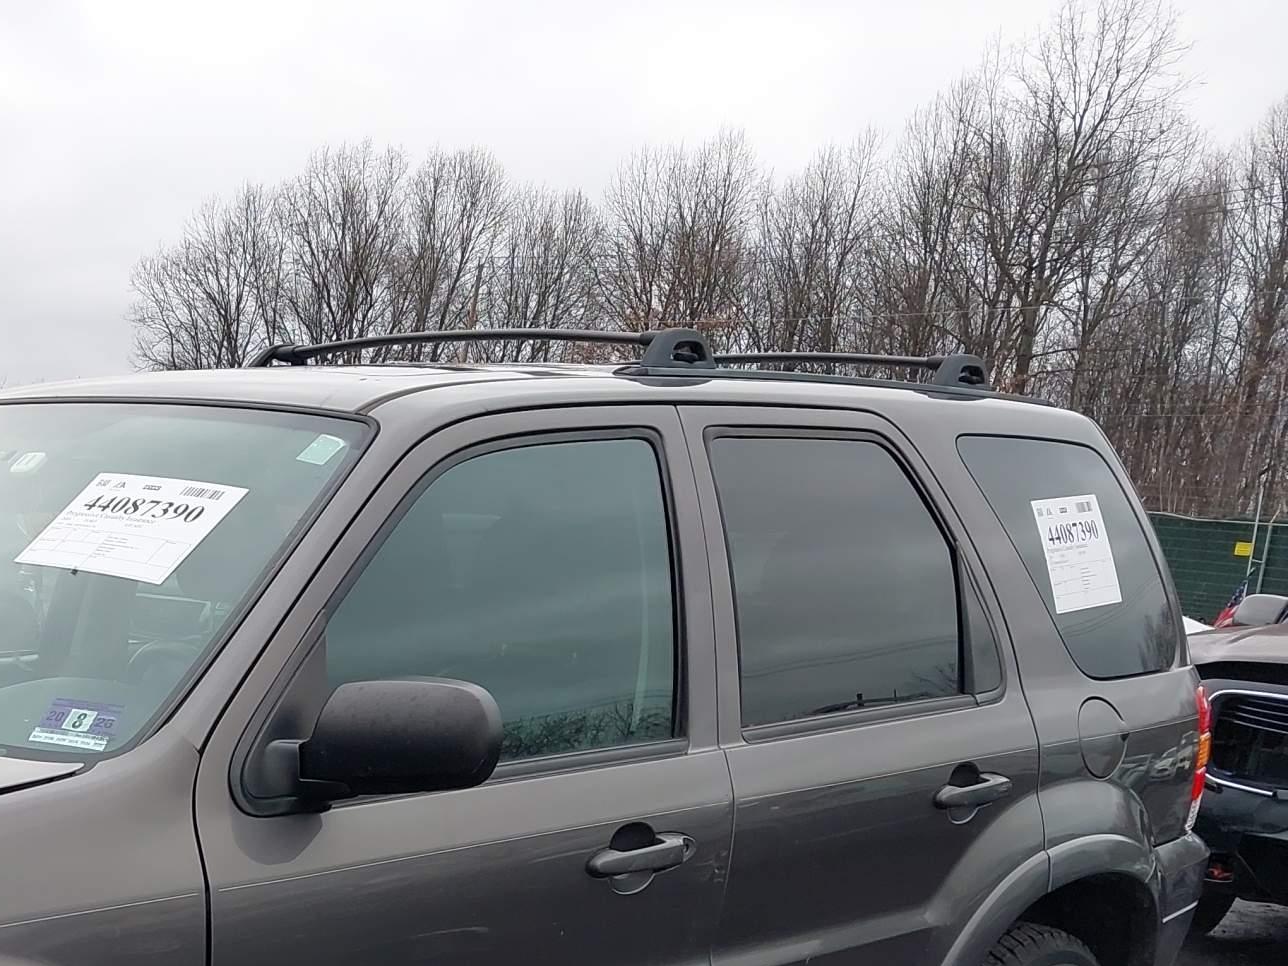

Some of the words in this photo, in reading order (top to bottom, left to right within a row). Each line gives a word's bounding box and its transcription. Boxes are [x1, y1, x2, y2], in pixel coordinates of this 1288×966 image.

[84, 495, 205, 523] 44087390
[1048, 520, 1099, 545] 44087390
[71, 712, 88, 729] 8
